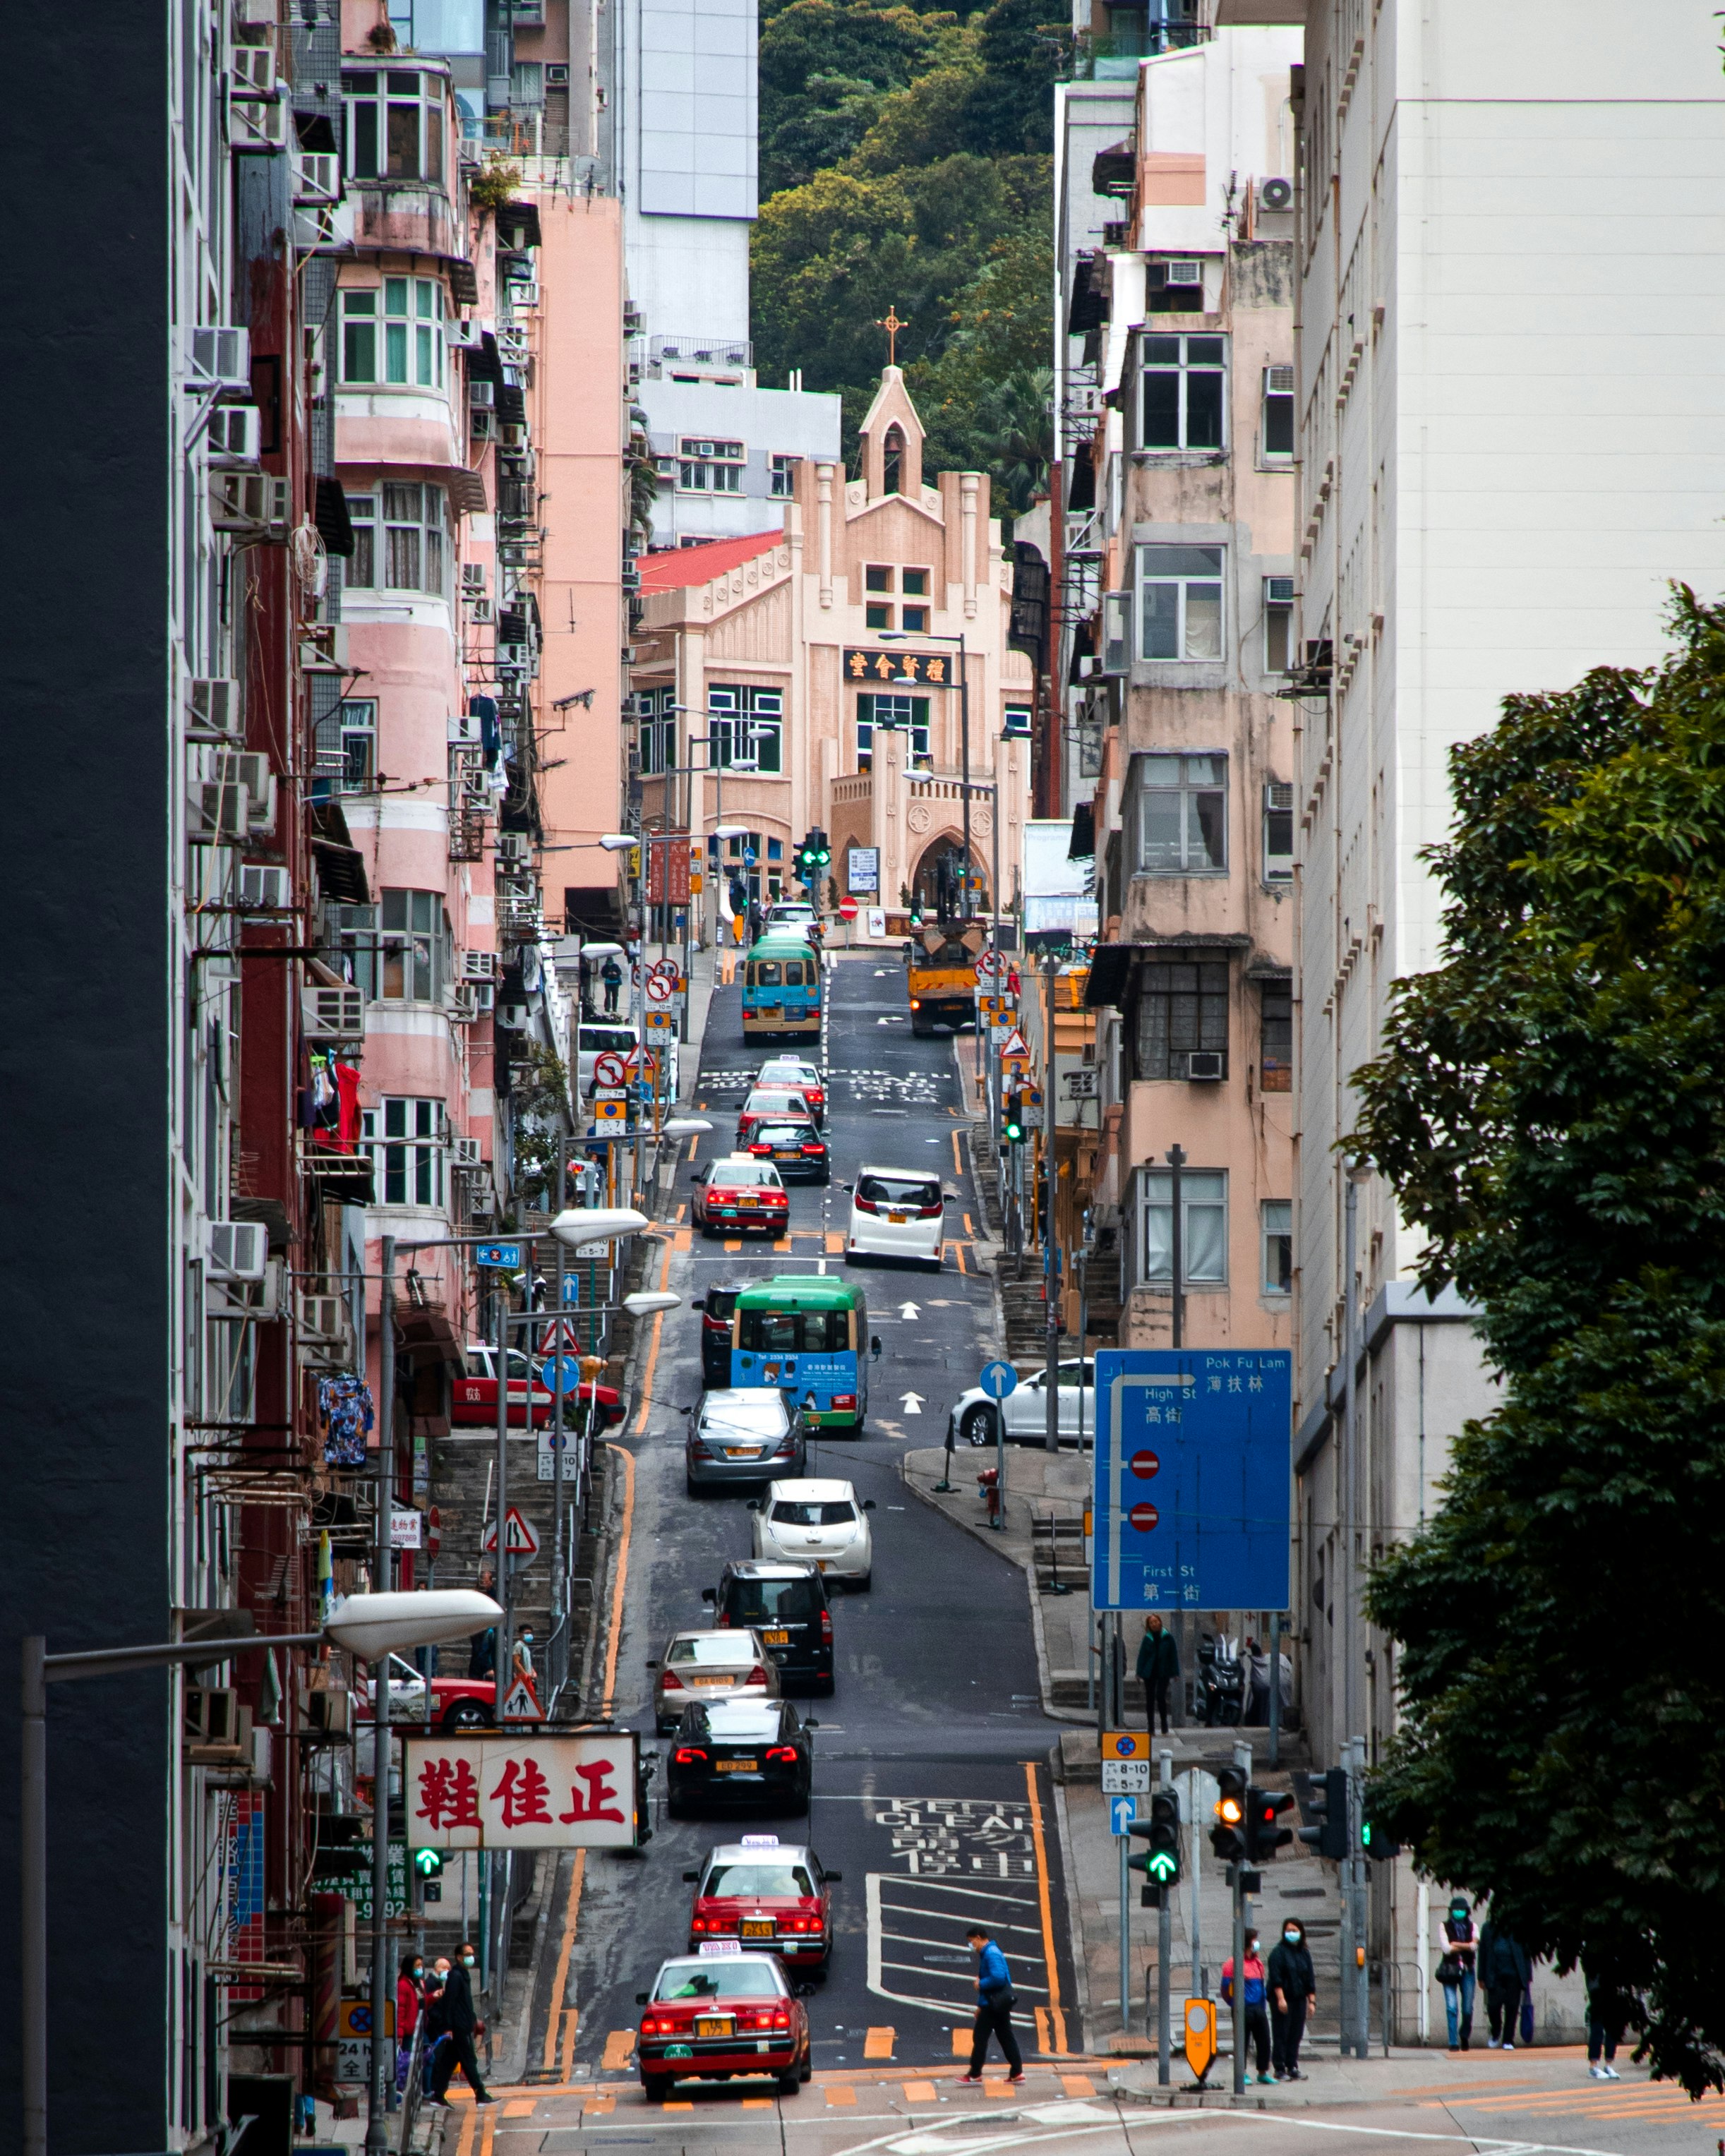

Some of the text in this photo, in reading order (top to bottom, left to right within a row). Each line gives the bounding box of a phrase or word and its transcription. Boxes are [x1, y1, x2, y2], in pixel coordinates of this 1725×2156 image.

[1206, 1357, 1285, 1368] Pok Fu Lam
[1206, 1375, 1263, 1393] 薄扶林
[1145, 1388, 1197, 1402] High St
[1146, 1406, 1182, 1424] 高街
[1143, 1565, 1195, 1577] First St
[1143, 1583, 1200, 1602] 第一街
[736, 1760, 752, 1770] 299
[1120, 1764, 1148, 1774] 8-10
[415, 1757, 626, 1831] 正佳鞋
[891, 1800, 1026, 1817] KEEP
[876, 1812, 1045, 1831] CLEAR
[891, 1825, 1033, 1852] 請勿
[890, 1848, 1037, 1878] 停車
[703, 1942, 738, 1952] TAXI
[339, 2043, 358, 2055] 24
